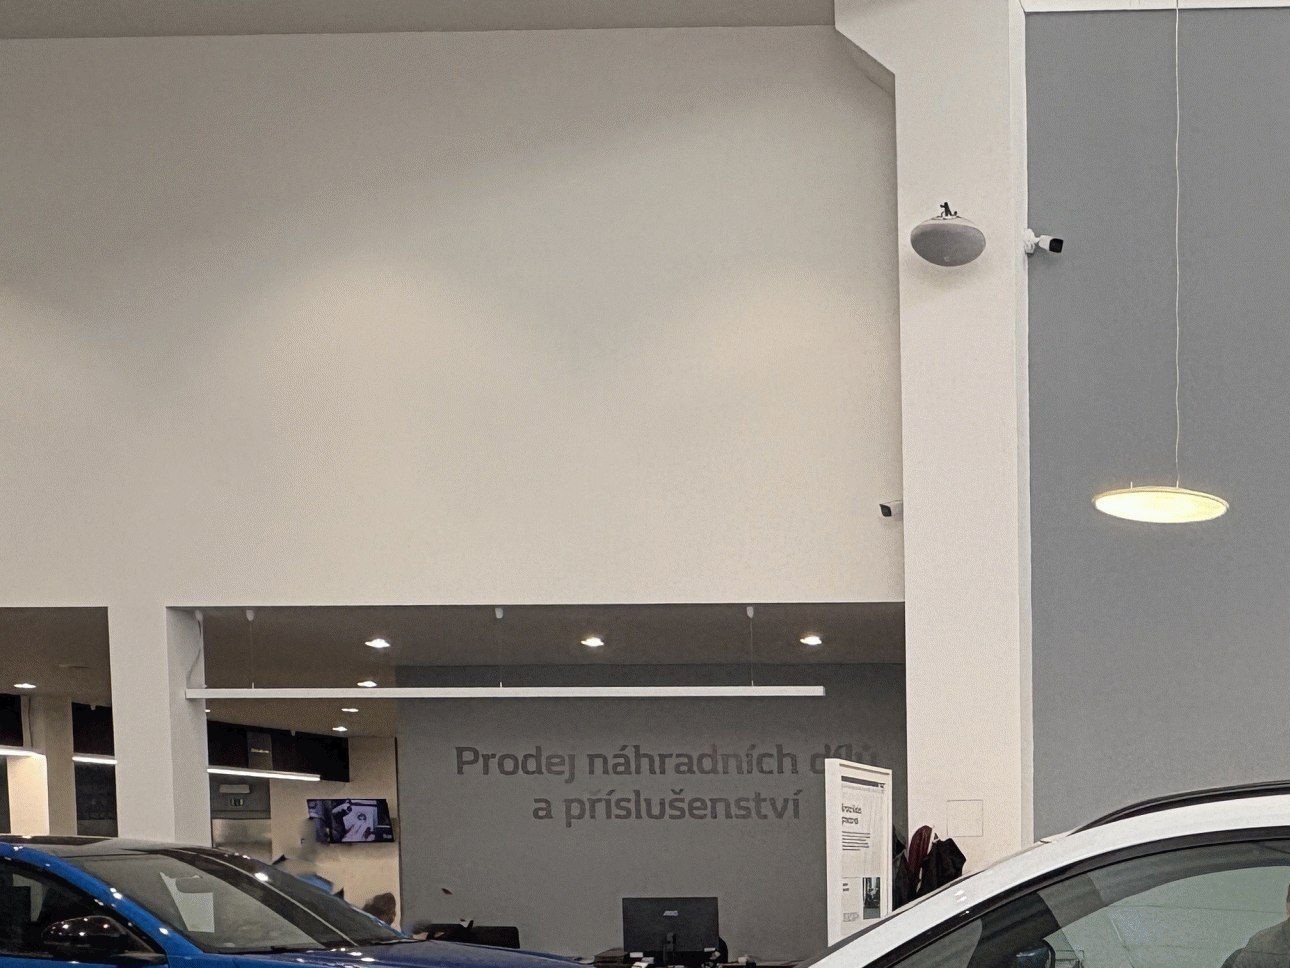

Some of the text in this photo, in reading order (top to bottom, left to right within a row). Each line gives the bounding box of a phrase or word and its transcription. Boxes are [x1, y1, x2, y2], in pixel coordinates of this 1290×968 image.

[455, 745, 576, 784] Prodej
[586, 743, 799, 775] náhradních
[532, 797, 554, 820] a
